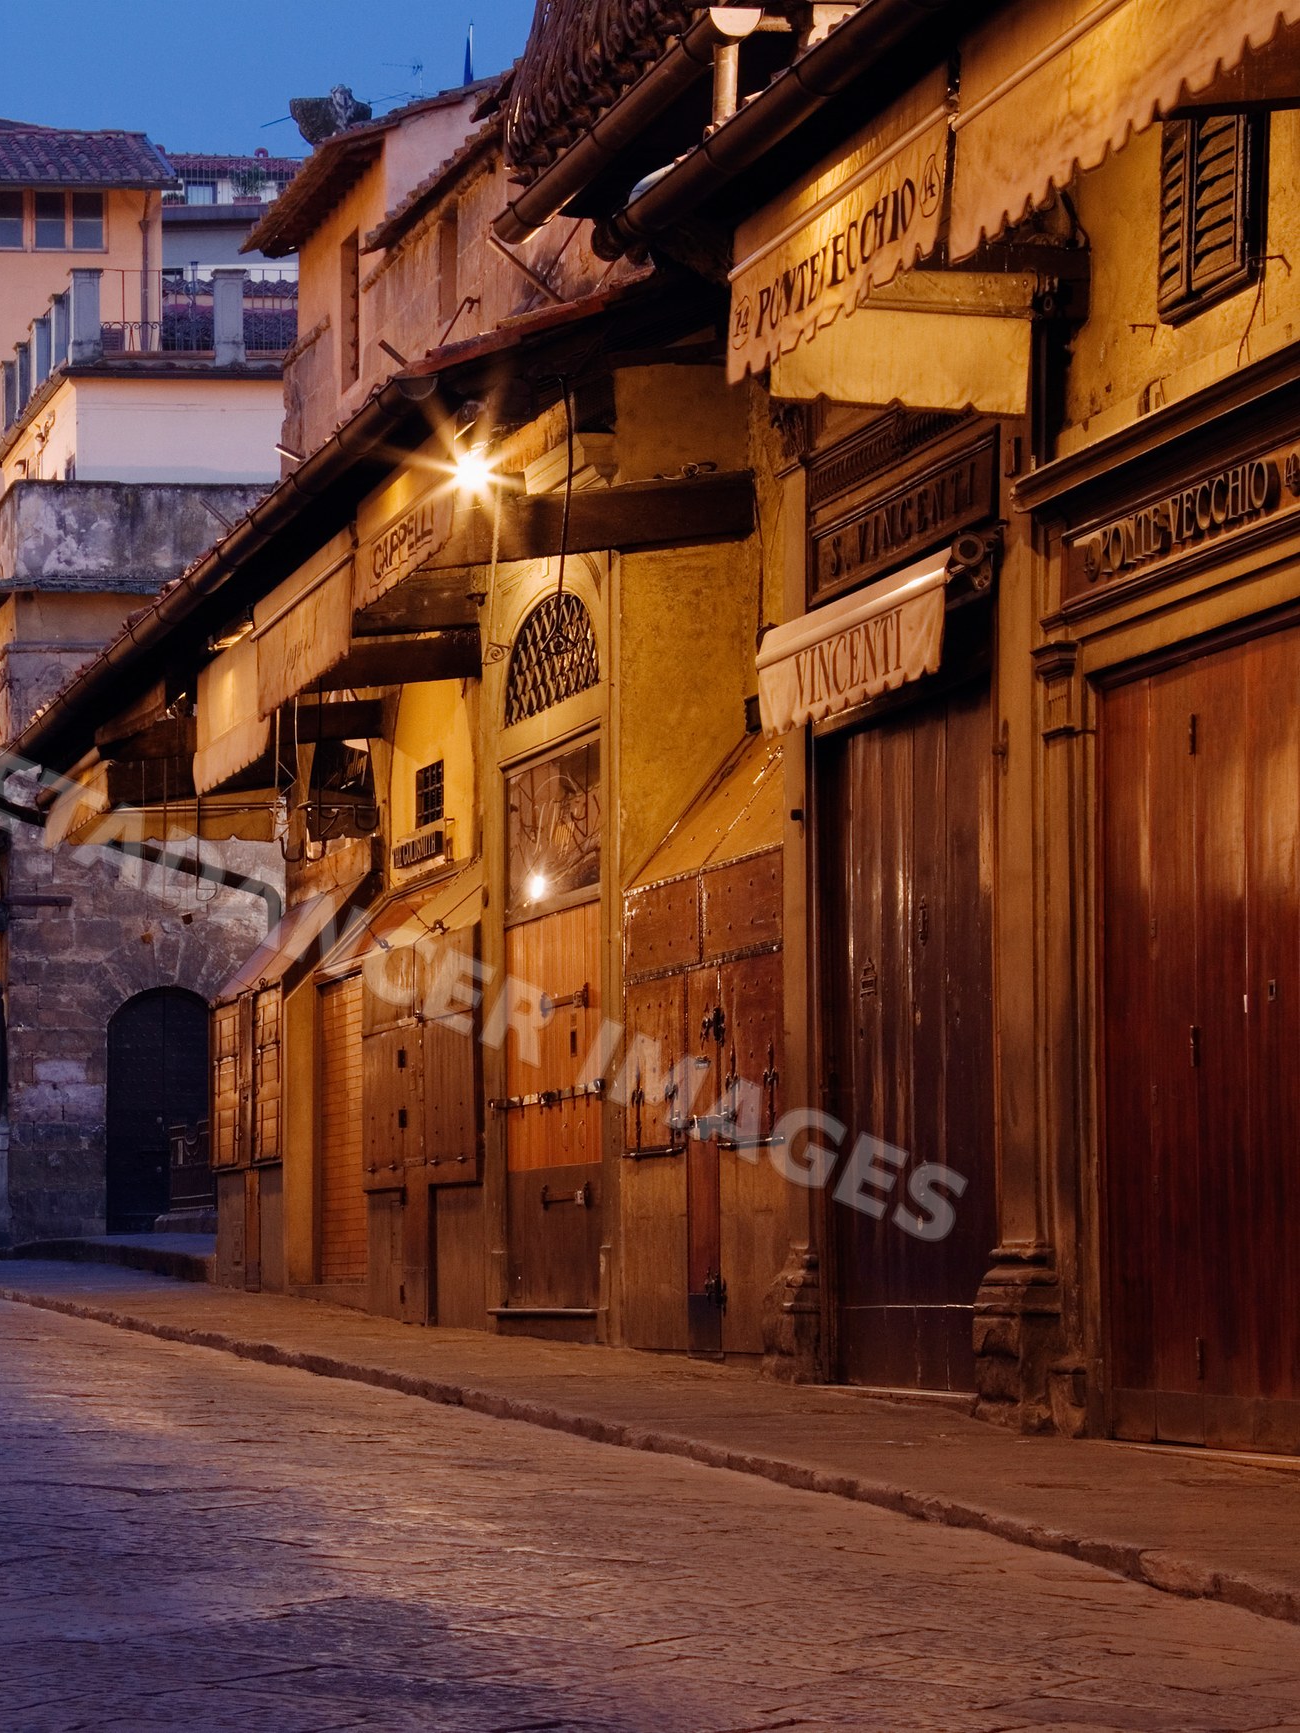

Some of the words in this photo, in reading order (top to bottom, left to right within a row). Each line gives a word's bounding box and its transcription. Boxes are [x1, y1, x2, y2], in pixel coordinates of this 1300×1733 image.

[733, 305, 750, 338] 14
[755, 256, 819, 338] PONTE
[373, 501, 434, 579] CAPPELLI
[831, 536, 851, 575] S.
[858, 462, 976, 563] VINCENTI
[1100, 504, 1163, 575] PONTE
[1170, 458, 1269, 544] VECCHIO
[794, 609, 903, 709] VINCENTI
